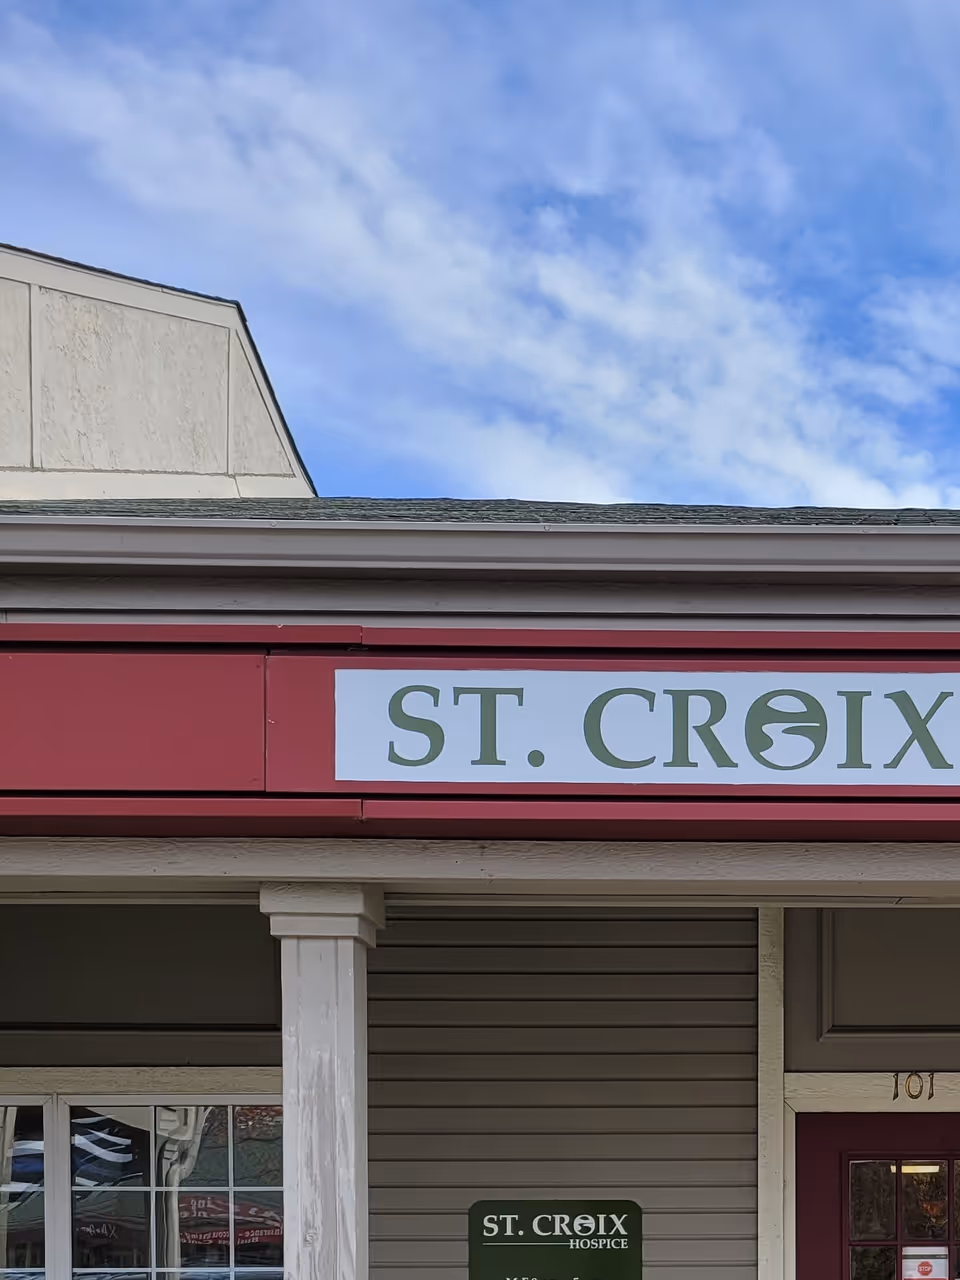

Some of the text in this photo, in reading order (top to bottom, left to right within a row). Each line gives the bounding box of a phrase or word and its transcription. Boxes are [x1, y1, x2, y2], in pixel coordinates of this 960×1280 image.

[387, 684, 546, 768] ST.
[583, 686, 954, 771] CROIX
[892, 1072, 935, 1101] 101
[482, 1214, 628, 1237] ST. CROIX
[569, 1238, 629, 1249] HOSPICE
